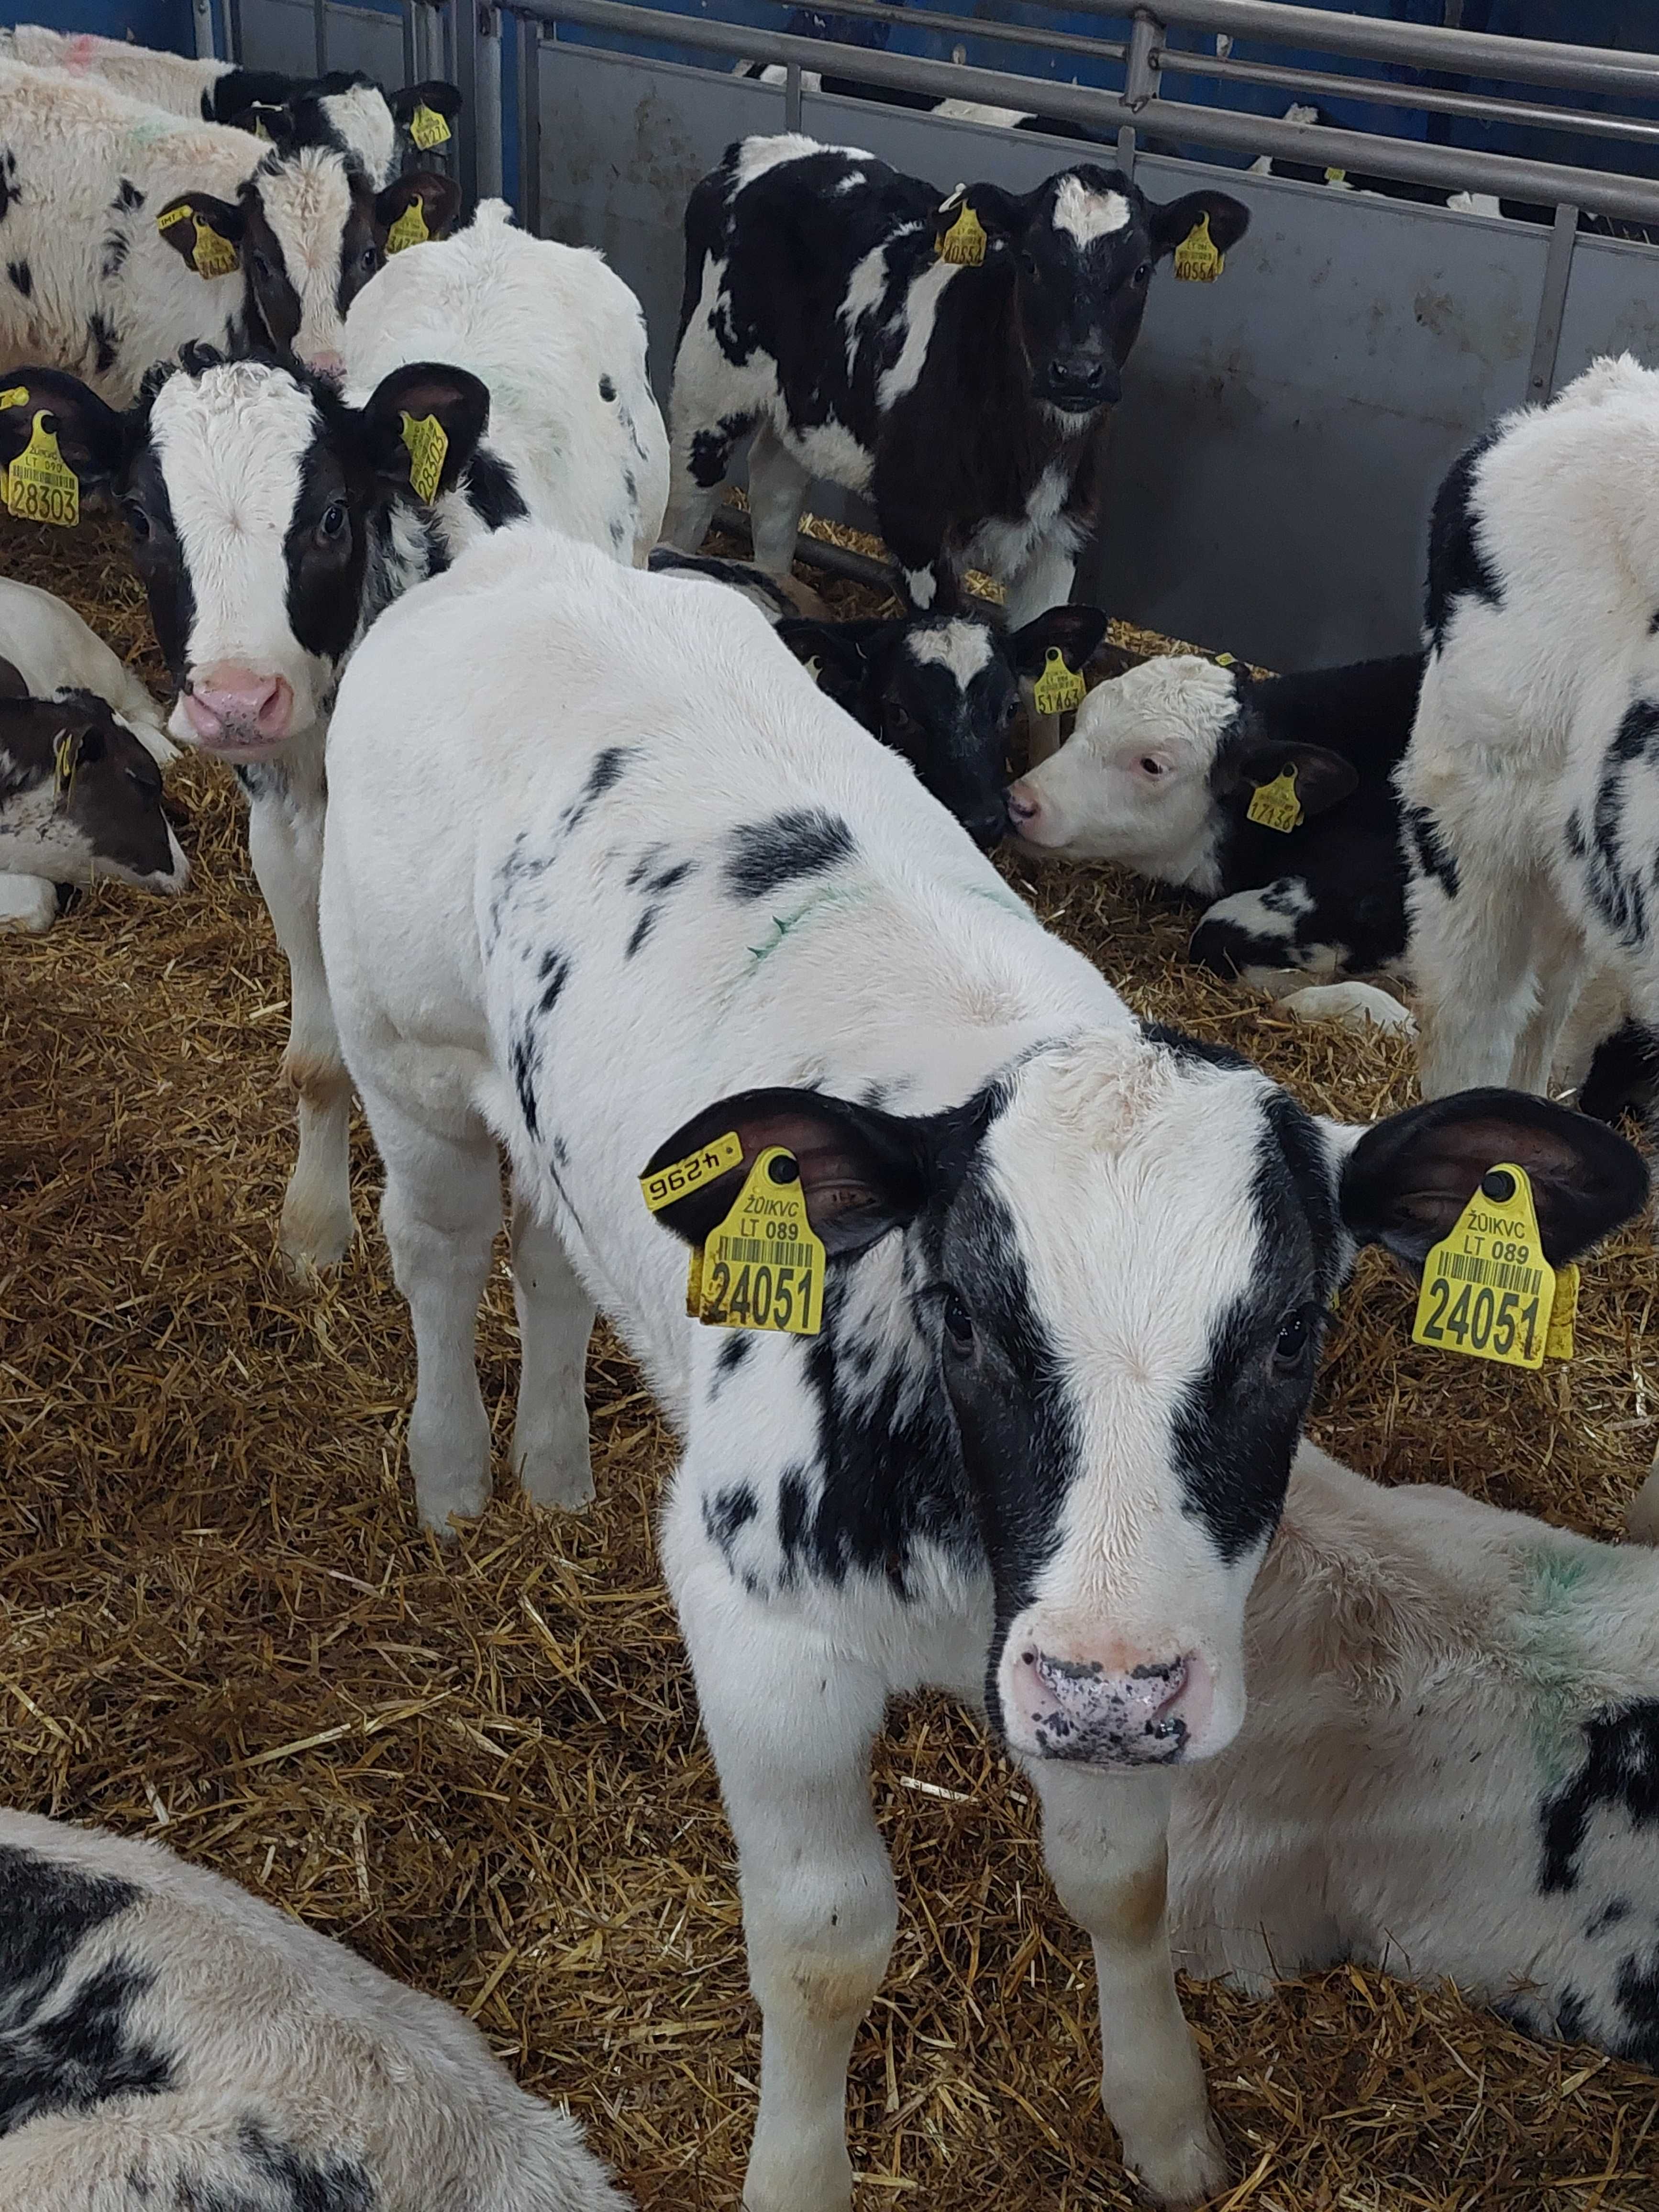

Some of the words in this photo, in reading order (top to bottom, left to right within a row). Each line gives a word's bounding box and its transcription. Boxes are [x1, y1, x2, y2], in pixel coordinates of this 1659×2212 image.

[1175, 261, 1214, 280] 40554
[25, 456, 37, 467] LT
[418, 436, 444, 502] 28303
[13, 480, 76, 522] 28303
[650, 1153, 719, 1200] 4296
[741, 1218, 759, 1237] LT
[765, 1220, 799, 1240] 089
[1463, 1235, 1485, 1256] LT
[1492, 1241, 1529, 1264] 089
[708, 1262, 812, 1329] 24051
[1422, 1278, 1539, 1361] 24051
